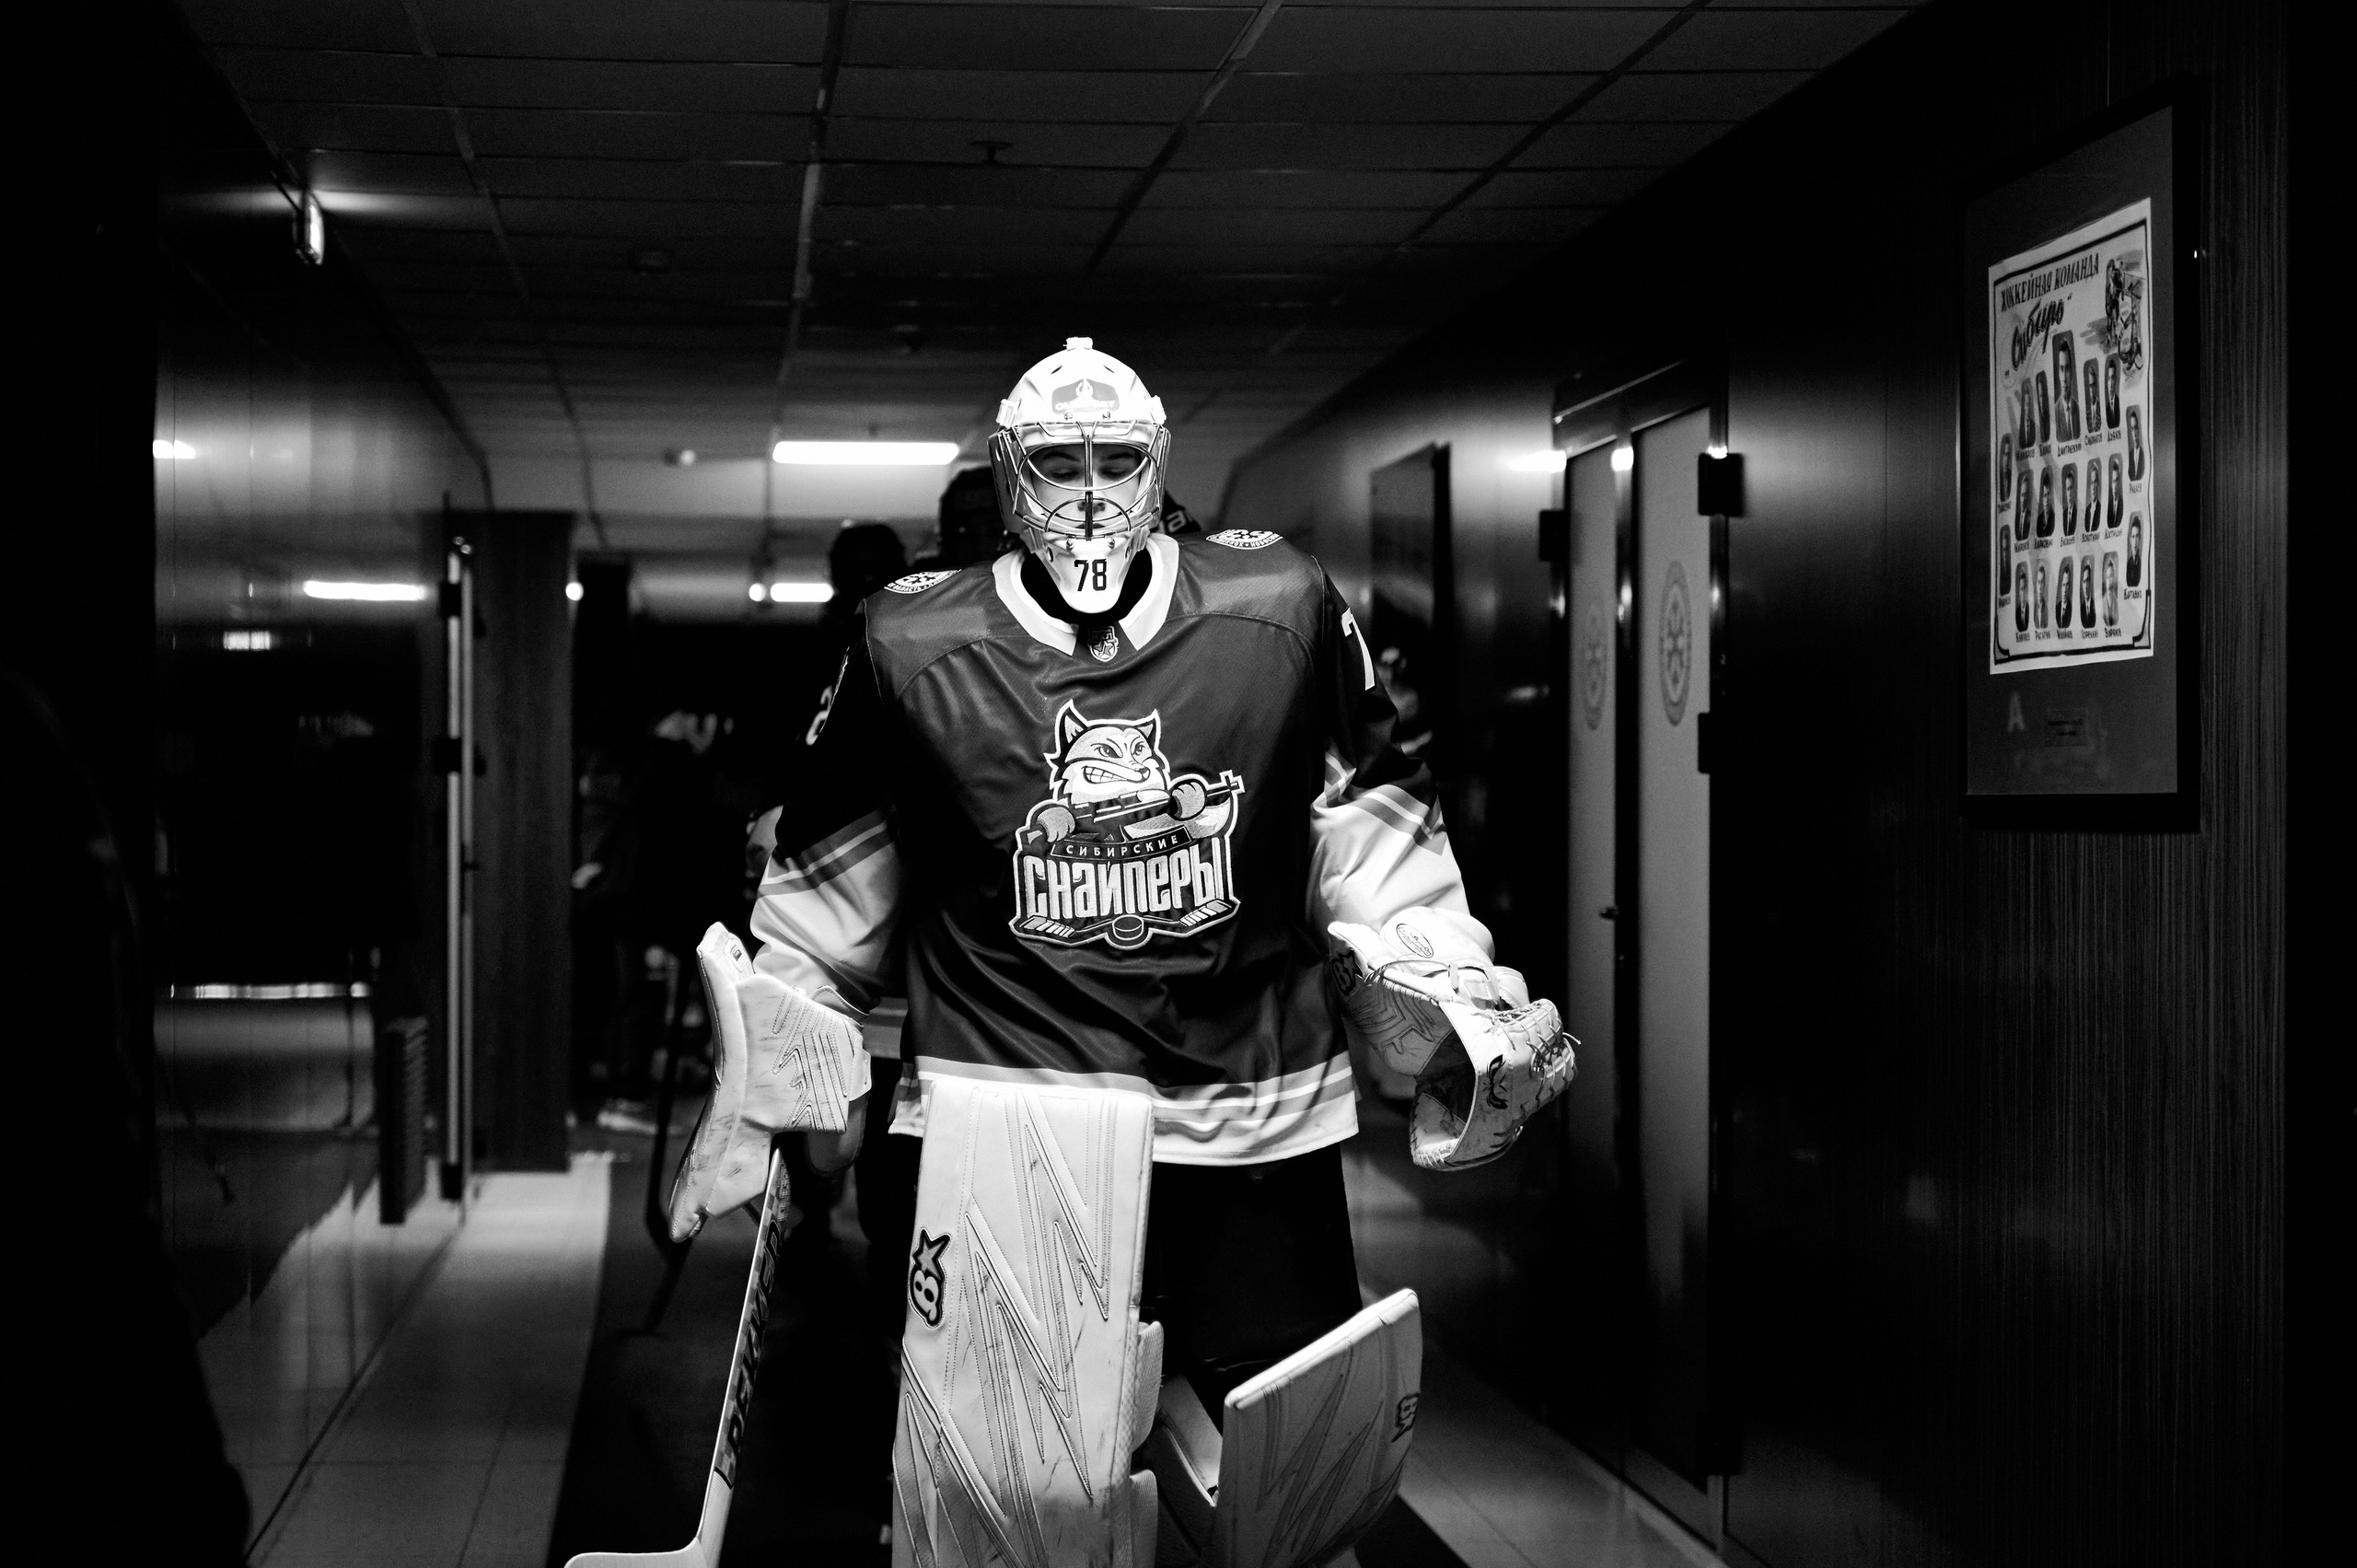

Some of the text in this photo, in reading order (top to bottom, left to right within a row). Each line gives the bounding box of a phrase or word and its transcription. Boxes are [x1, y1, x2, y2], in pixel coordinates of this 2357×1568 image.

[2001, 252, 2100, 312] ХОККЕЙНАЯ КОМАНДА
[1074, 558, 1108, 592] 78
[1065, 834, 1179, 858] СИБИРСКИЕ
